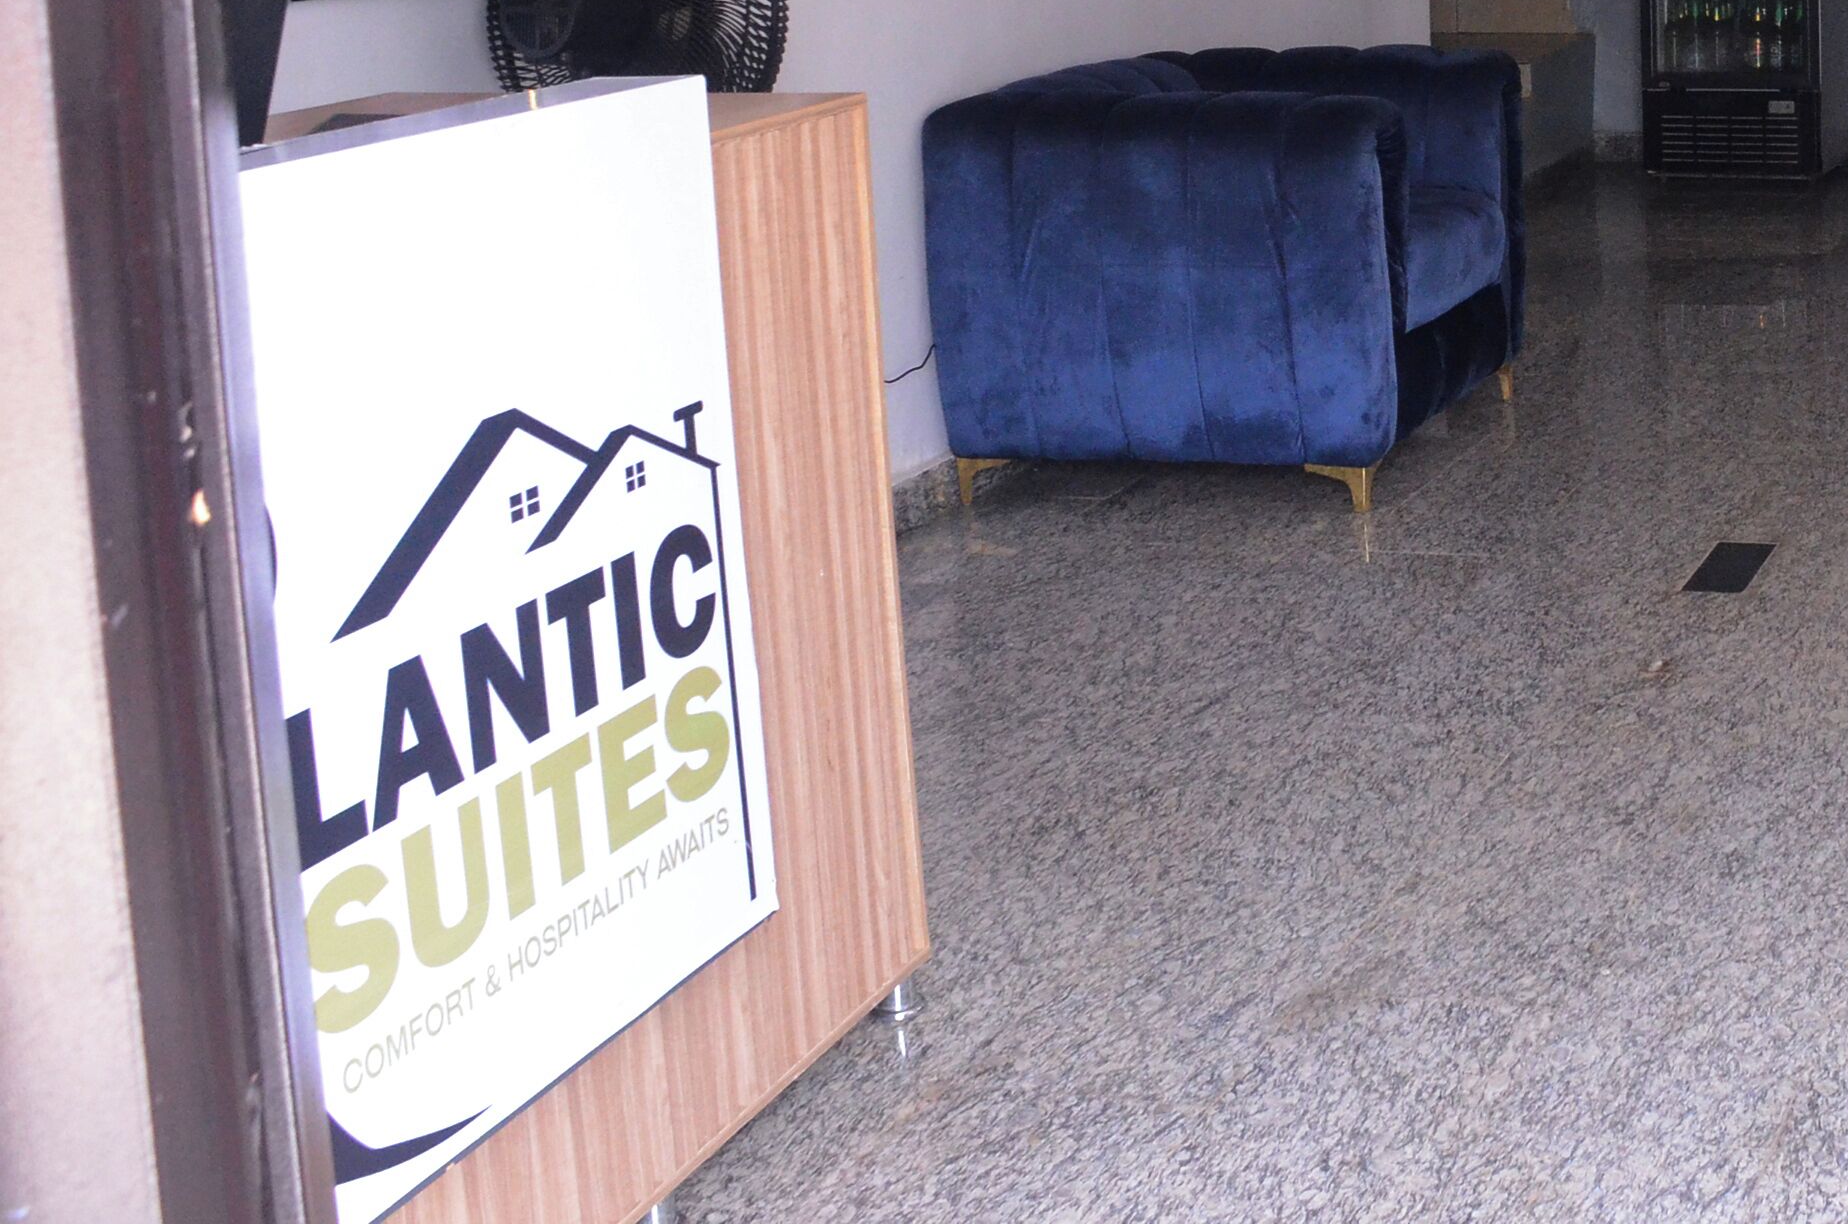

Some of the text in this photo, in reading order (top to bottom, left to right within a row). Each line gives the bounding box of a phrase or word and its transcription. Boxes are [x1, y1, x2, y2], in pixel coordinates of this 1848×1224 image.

[304, 666, 731, 1034] SUITES
[342, 807, 731, 1094] COMFORT & HOSPITALITY AWAITS
